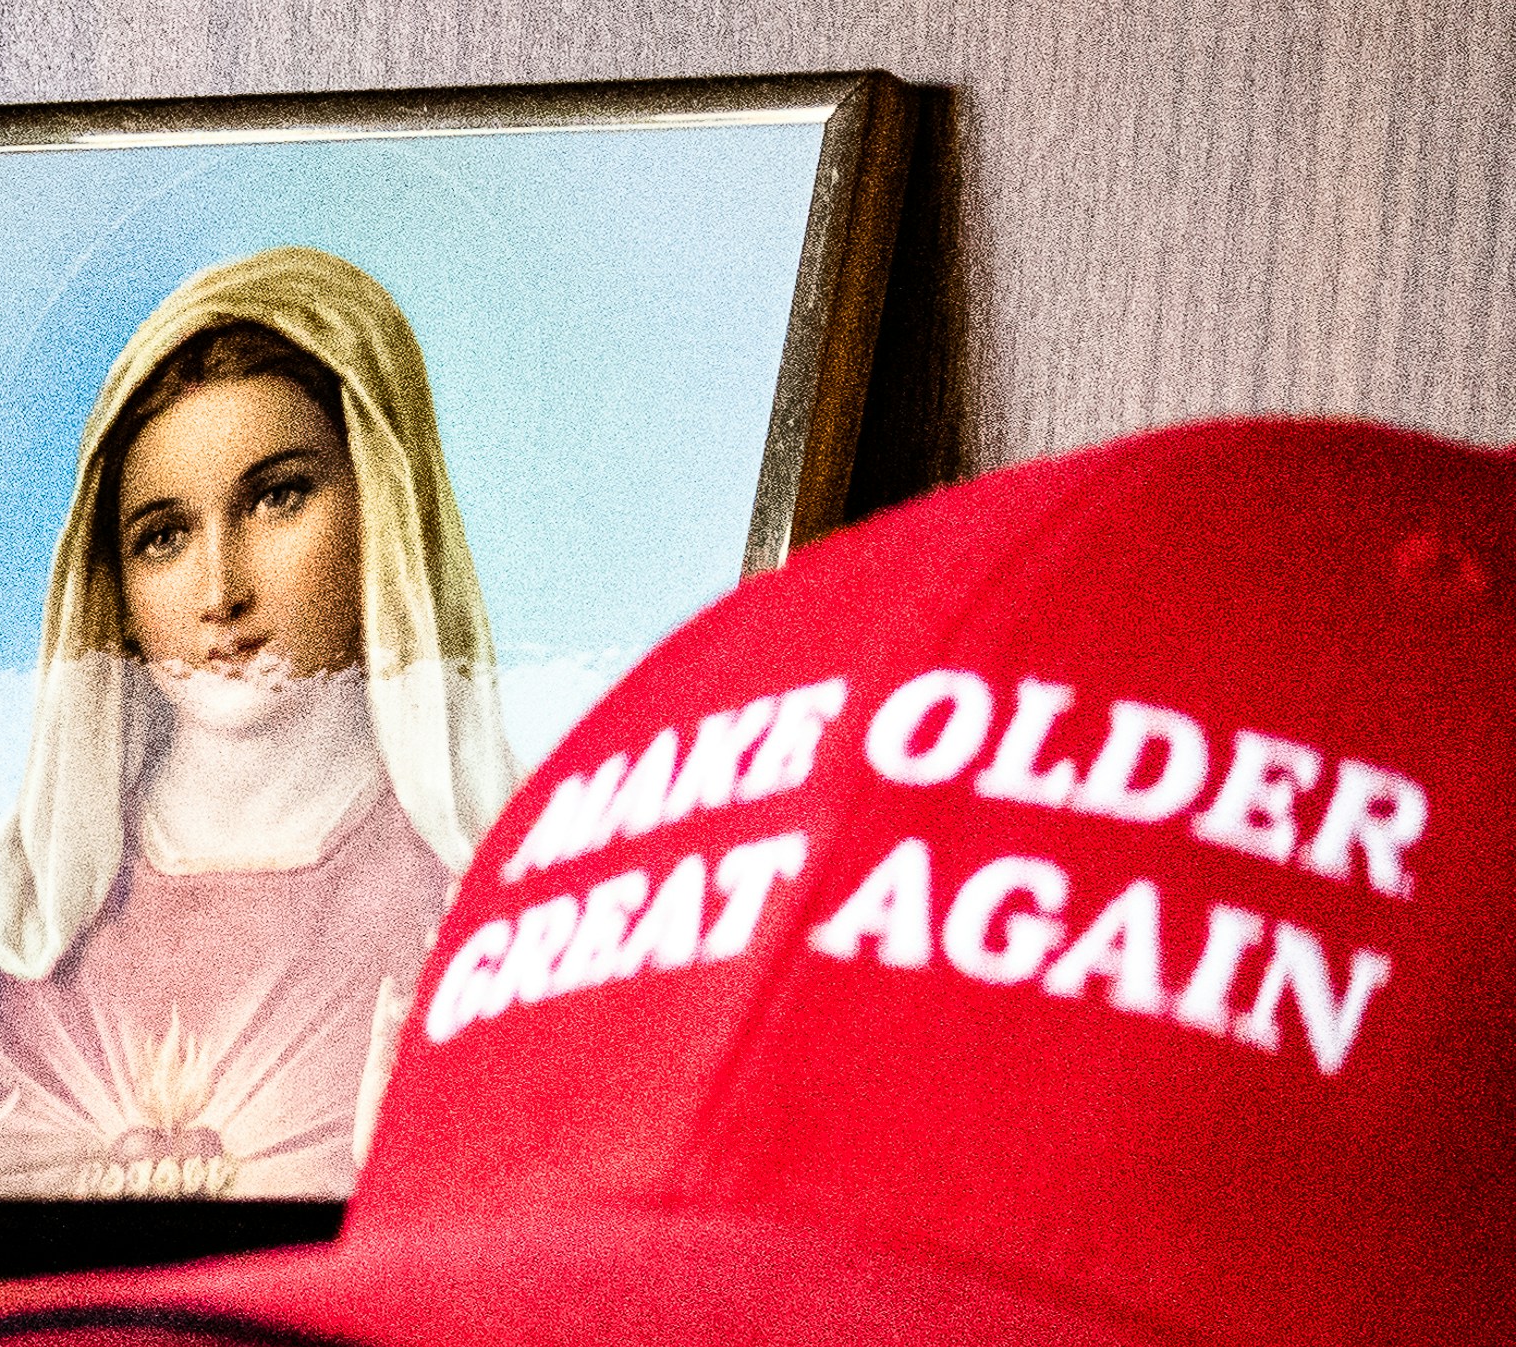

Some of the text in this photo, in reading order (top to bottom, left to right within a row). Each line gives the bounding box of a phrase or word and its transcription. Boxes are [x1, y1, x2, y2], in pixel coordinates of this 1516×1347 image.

[499, 667, 1431, 902] MAKE OLDER
[423, 831, 1392, 1079] GREAT AGAIN
